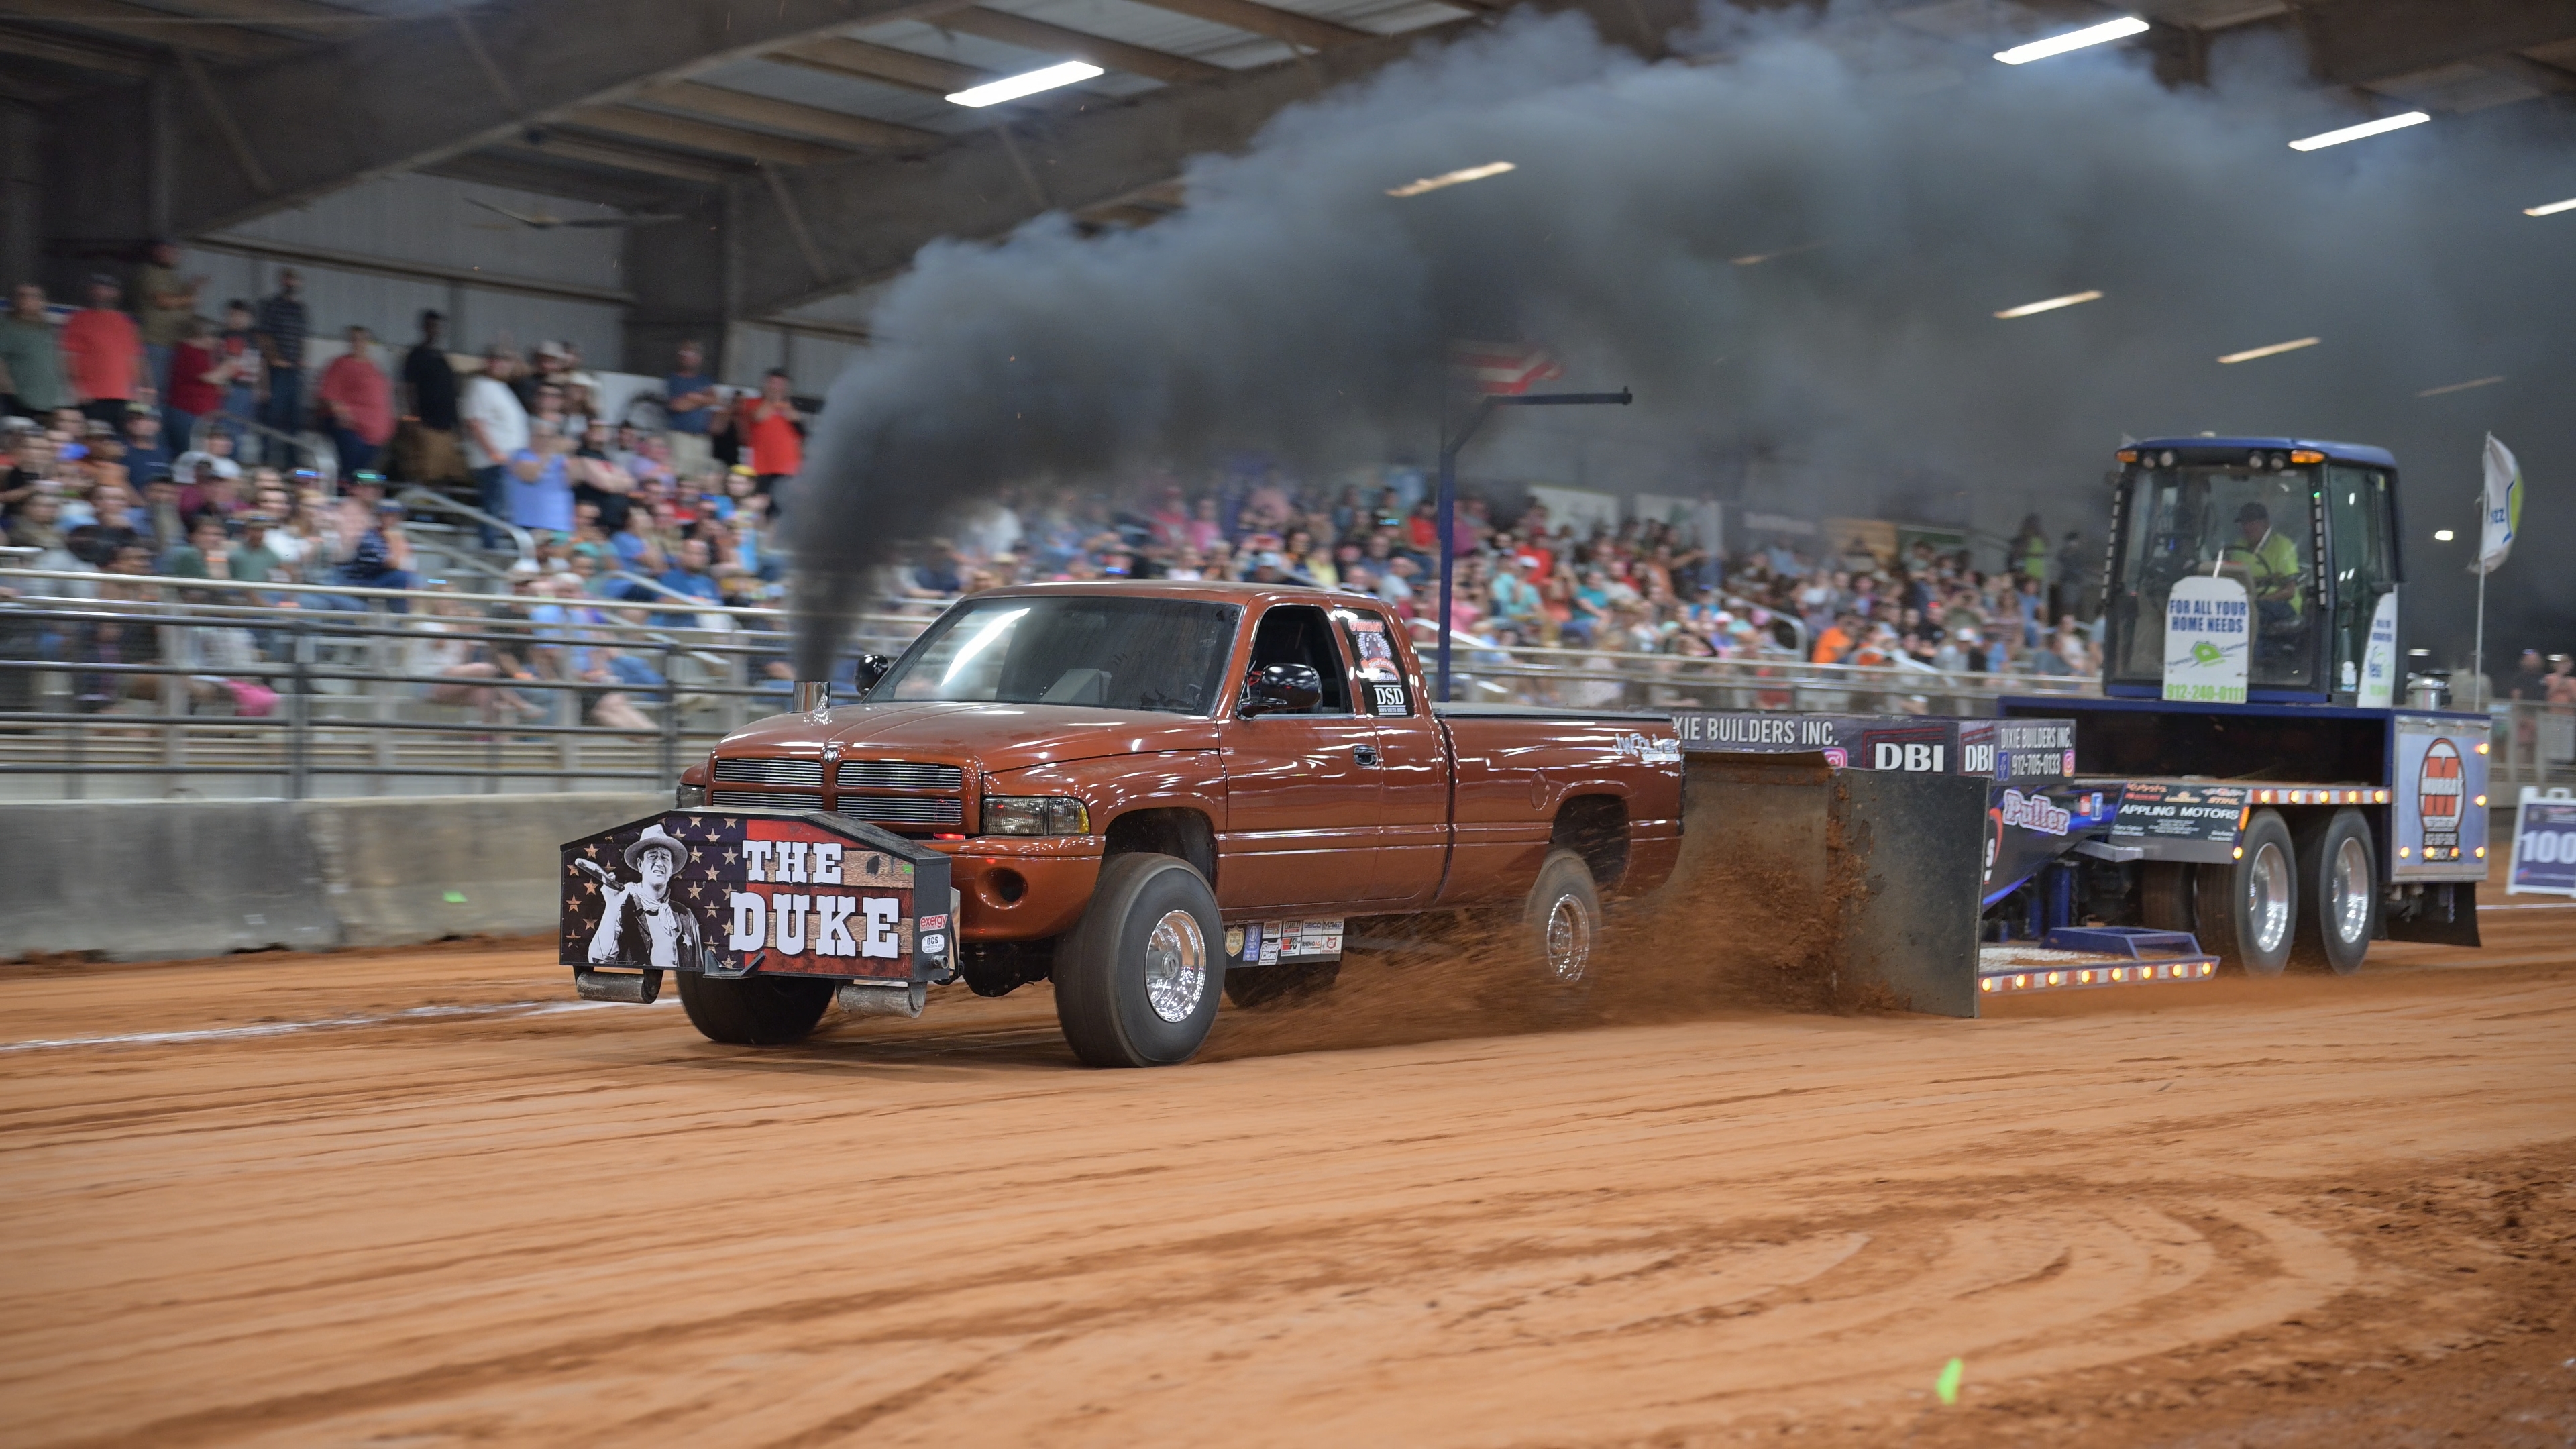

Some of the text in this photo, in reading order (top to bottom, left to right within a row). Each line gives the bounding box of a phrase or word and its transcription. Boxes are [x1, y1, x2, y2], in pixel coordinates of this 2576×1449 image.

[2169, 600, 2246, 616] FOR ALL YOUR
[2172, 617, 2243, 633] HOME NEEDS
[1374, 688, 1405, 705] DSD
[1672, 716, 1839, 746] XIE BUILDERS INC.
[2001, 727, 2021, 749] DIXIE
[2022, 727, 2056, 749] BUILDERS
[1875, 743, 1944, 772] DBI
[1964, 744, 1994, 772] DBI
[2206, 796, 2240, 805] STIHL
[2004, 790, 2069, 834] Puller
[2118, 804, 2240, 820] APPLING MOTORS
[742, 840, 842, 884] THE
[729, 891, 899, 959] DUKE
[920, 915, 947, 928] exergy
[1260, 951, 1277, 960] Clean
[1261, 943, 1279, 953] Super
